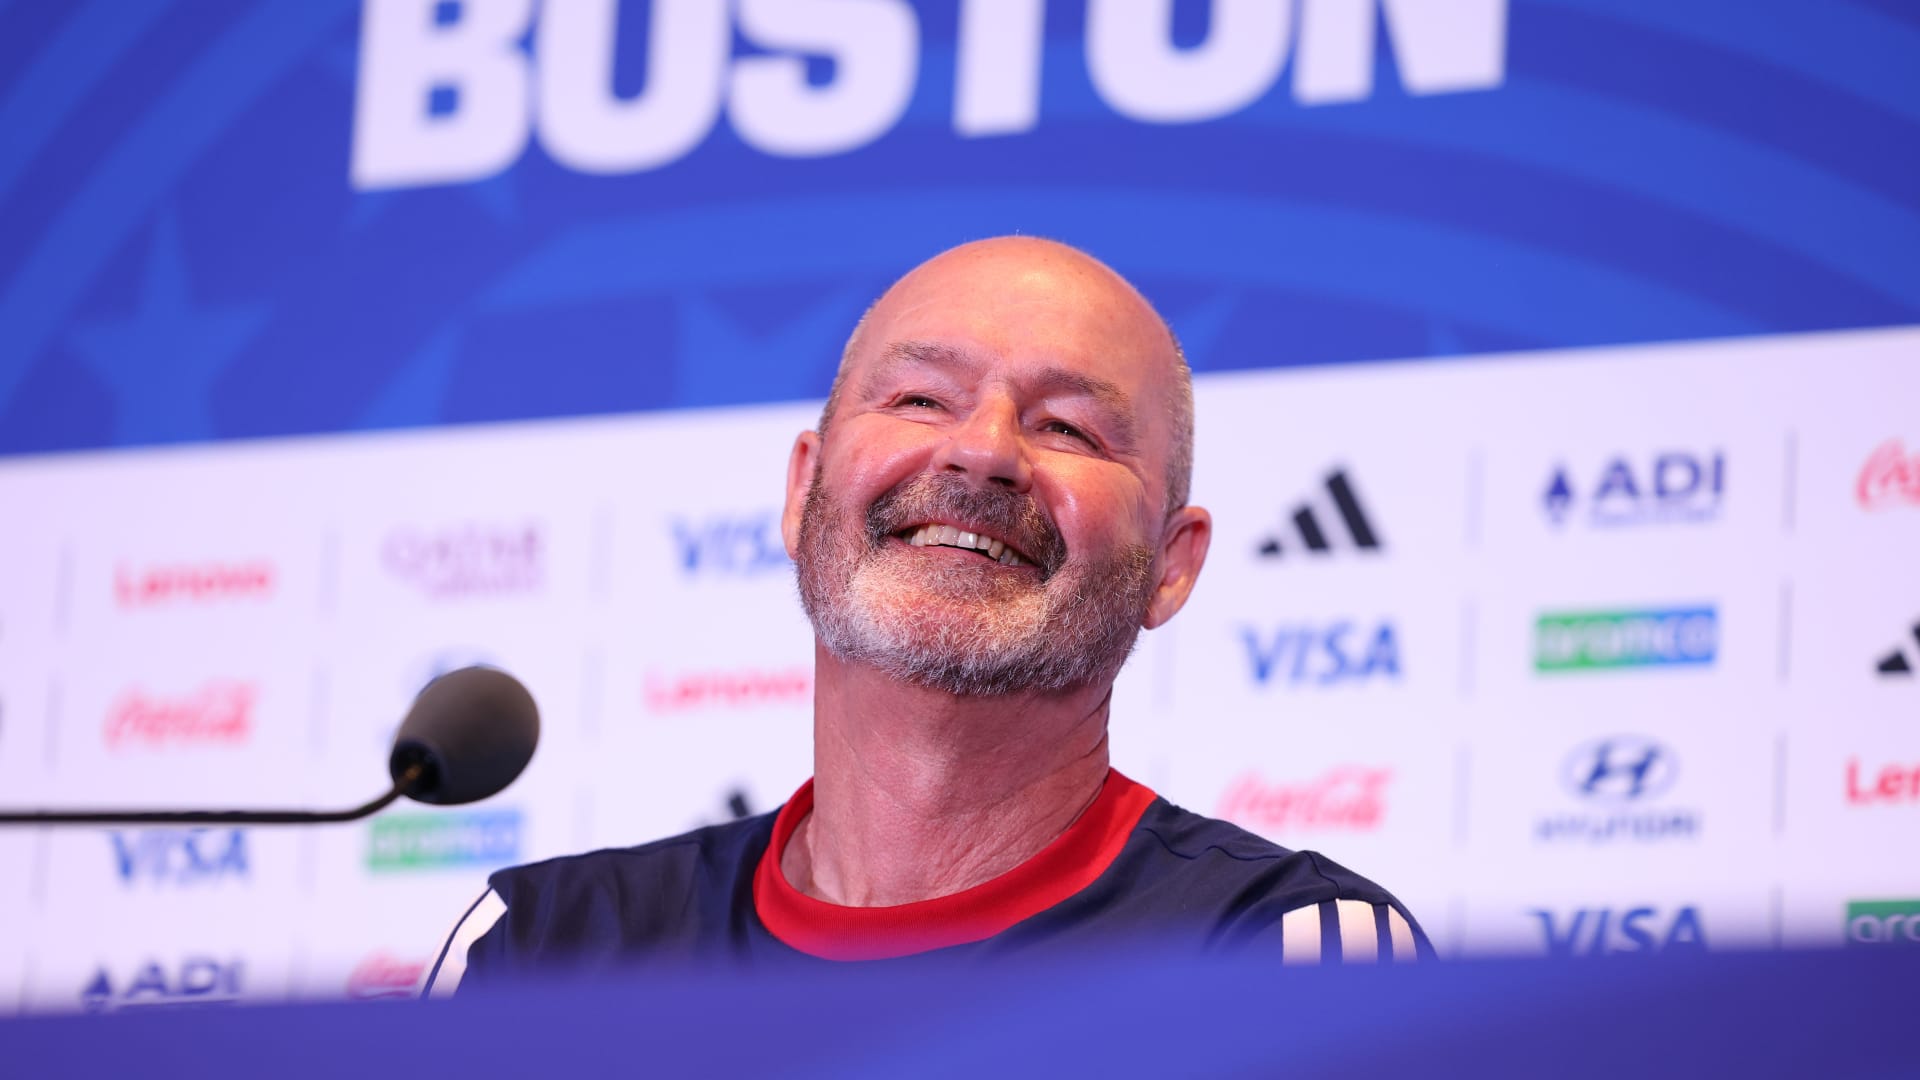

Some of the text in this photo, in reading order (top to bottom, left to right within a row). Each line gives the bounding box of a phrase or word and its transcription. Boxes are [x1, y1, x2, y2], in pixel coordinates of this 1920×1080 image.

[1590, 449, 1727, 501] ADI
[671, 512, 787, 577] VIS
[1241, 619, 1401, 687] VISA
[112, 827, 250, 882] VISA
[1530, 905, 1707, 955] VISA
[123, 957, 246, 997] ADI
